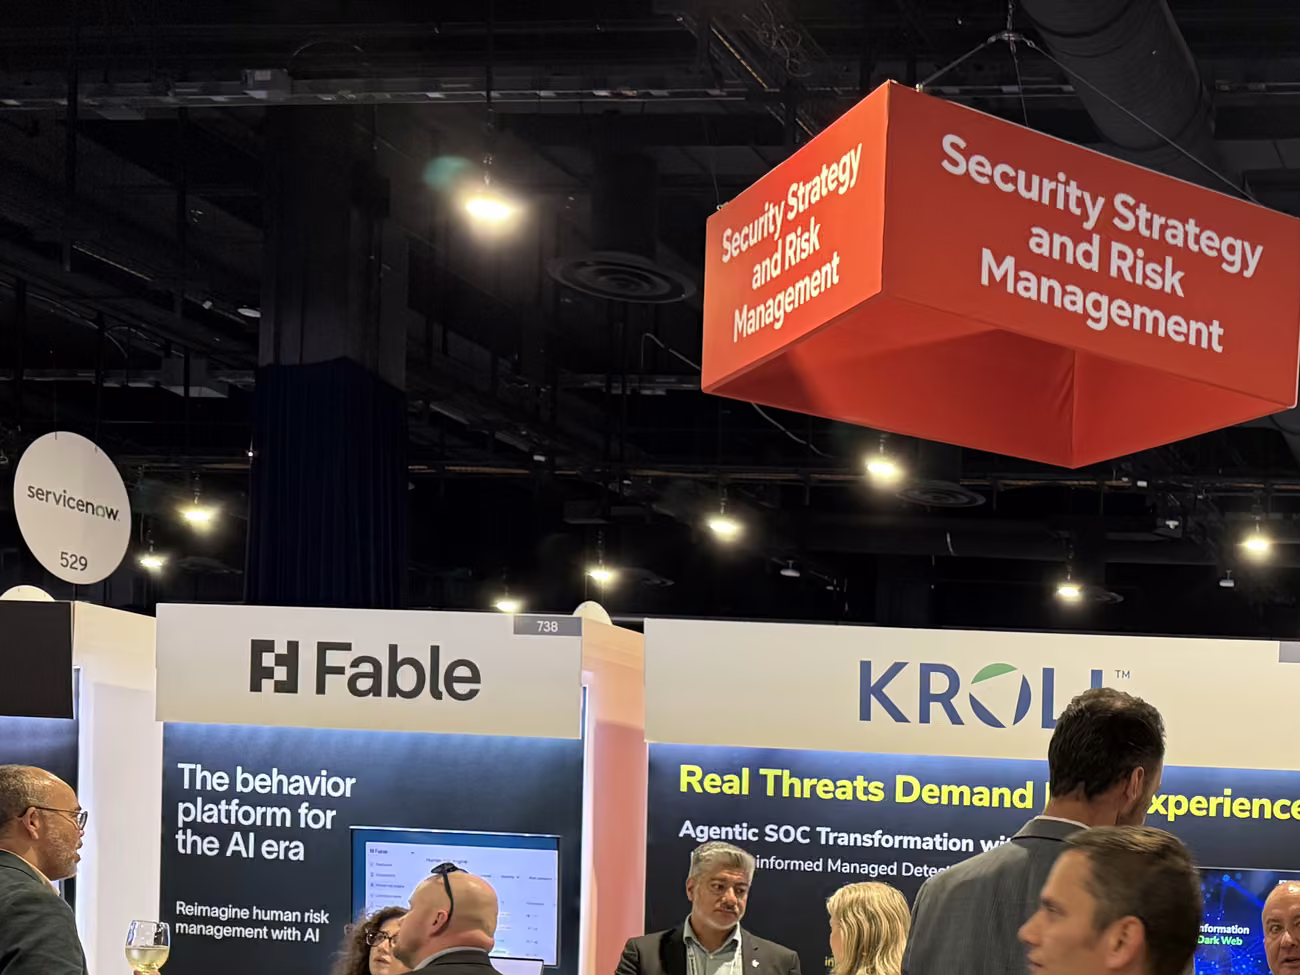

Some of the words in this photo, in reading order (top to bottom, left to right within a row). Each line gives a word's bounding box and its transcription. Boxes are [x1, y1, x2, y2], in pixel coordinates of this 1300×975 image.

[721, 196, 785, 264] Security
[786, 141, 862, 219] Strategy
[941, 133, 1105, 223] Security
[1113, 193, 1263, 278] Strategy
[752, 243, 783, 290] and
[784, 218, 820, 270] Risk
[1029, 223, 1100, 272] and
[1110, 246, 1185, 297] Risk
[734, 251, 840, 343] Management
[980, 247, 1224, 353] Management
[27, 485, 119, 521] servicenow
[60, 551, 88, 571] 529
[536, 620, 558, 634] 738
[315, 641, 481, 701] Fable
[177, 763, 229, 791] The
[236, 765, 356, 797] behavior
[679, 764, 750, 795] Real
[759, 768, 885, 802] Threats
[895, 775, 1034, 810] Demand
[177, 797, 291, 828] platform
[298, 802, 336, 829] for
[175, 829, 219, 856] the
[226, 831, 255, 858] AI
[261, 839, 304, 861] era
[678, 820, 759, 843] Agentic
[764, 826, 811, 844] SOC
[816, 827, 974, 852] Transformation
[827, 860, 897, 877] Managed
[176, 901, 249, 920] Reimagine
[253, 905, 300, 922] human
[304, 909, 329, 924] risk
[1200, 924, 1250, 934] nformation
[175, 922, 268, 939] management
[271, 929, 301, 941] with
[304, 927, 320, 942] AI
[1198, 935, 1219, 945] Dark
[1221, 936, 1243, 946] Web
